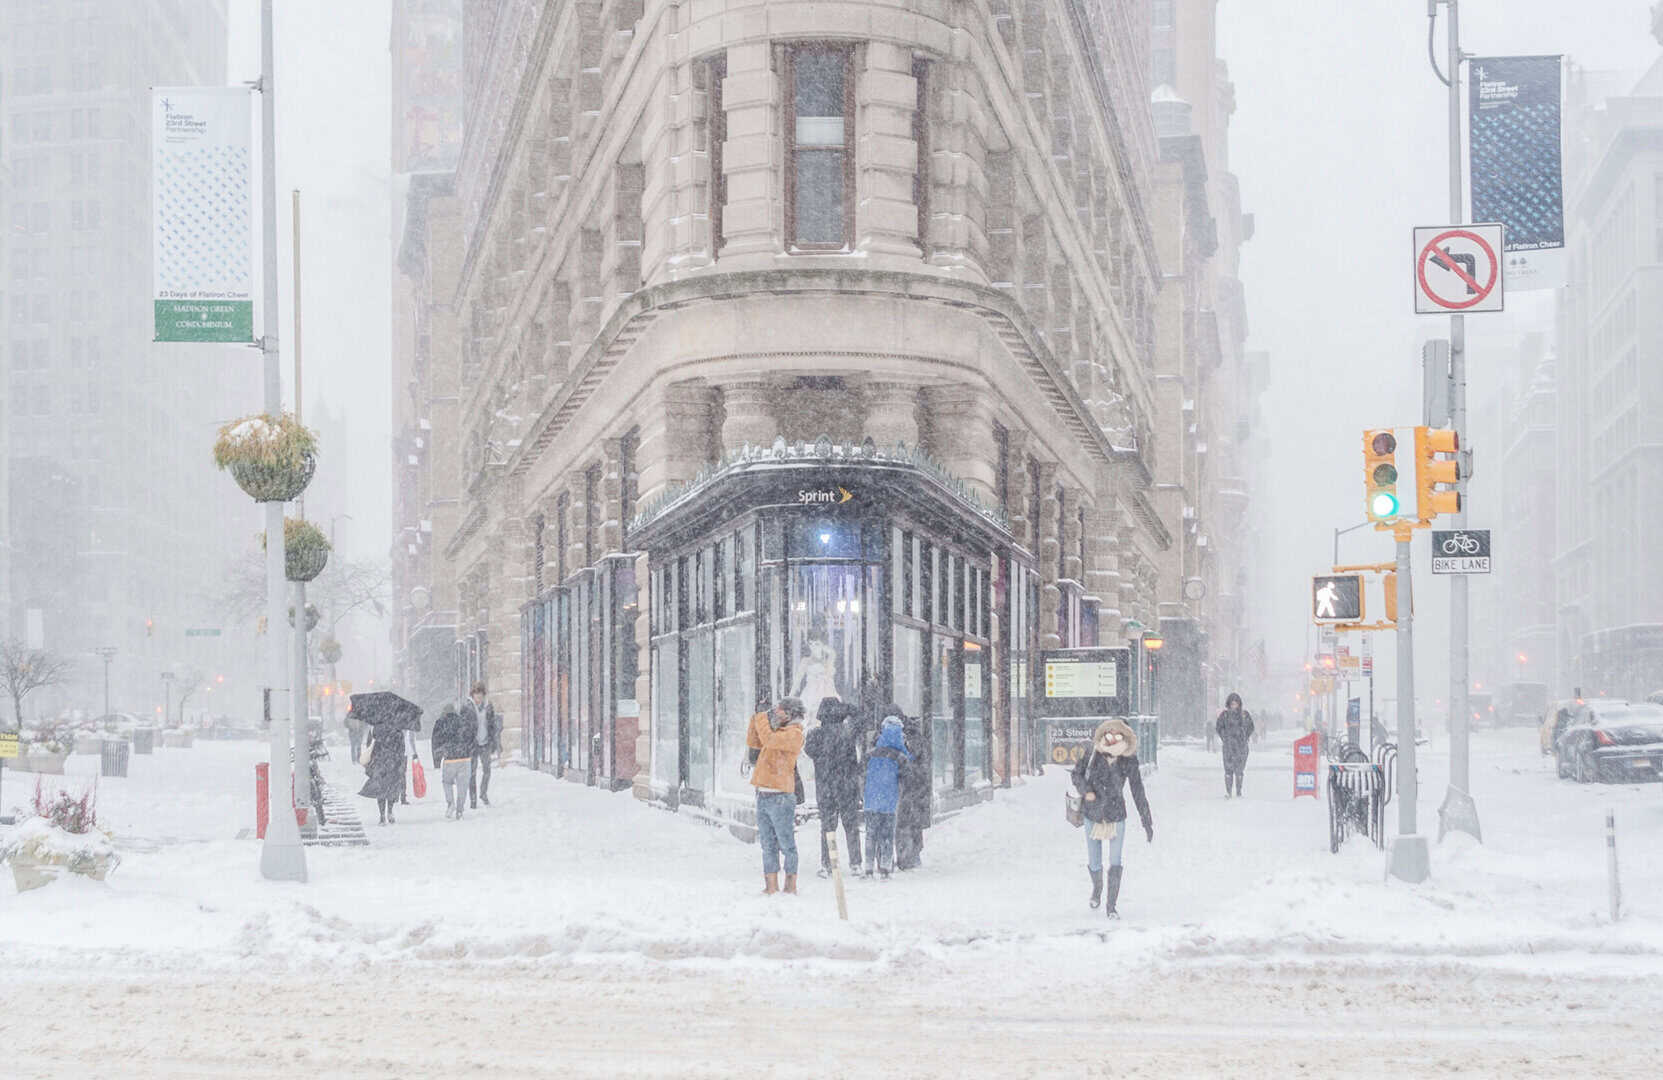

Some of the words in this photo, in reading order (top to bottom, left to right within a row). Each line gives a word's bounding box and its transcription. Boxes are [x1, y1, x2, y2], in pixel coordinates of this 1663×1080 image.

[798, 490, 835, 504] Sprint
[1435, 560, 1456, 570] BIKE
[1462, 559, 1489, 569] LANE
[1065, 728, 1092, 737] Street
